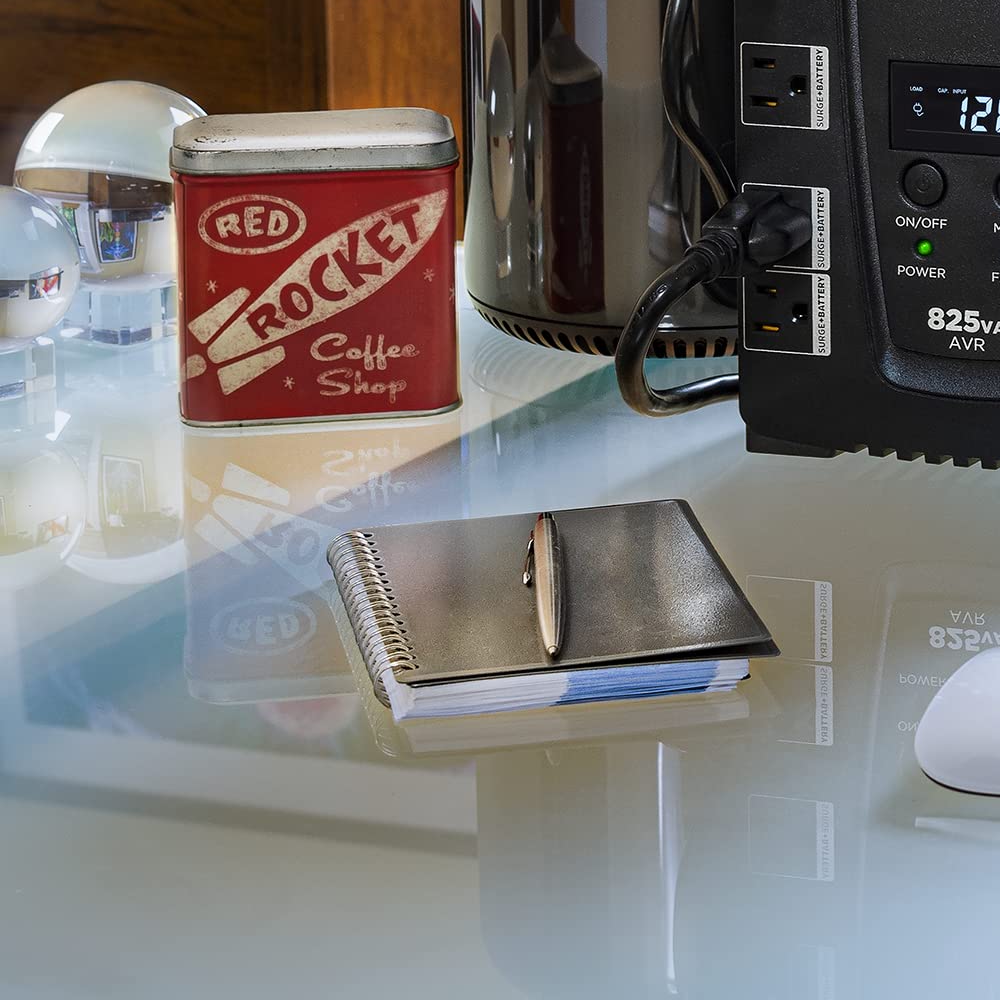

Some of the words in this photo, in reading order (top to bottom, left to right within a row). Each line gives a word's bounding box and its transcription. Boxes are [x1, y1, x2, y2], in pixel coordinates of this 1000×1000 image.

[816, 49, 824, 128] SURGE+BATTERY
[215, 205, 289, 238] RED
[817, 190, 825, 268] SURGE+BATTERY
[895, 215, 948, 230] ON/OFF
[247, 203, 422, 340] ROCKET
[897, 265, 946, 279] POWER
[310, 332, 420, 371] Coffee
[949, 336, 986, 351] AVR
[316, 368, 407, 403] Shop
